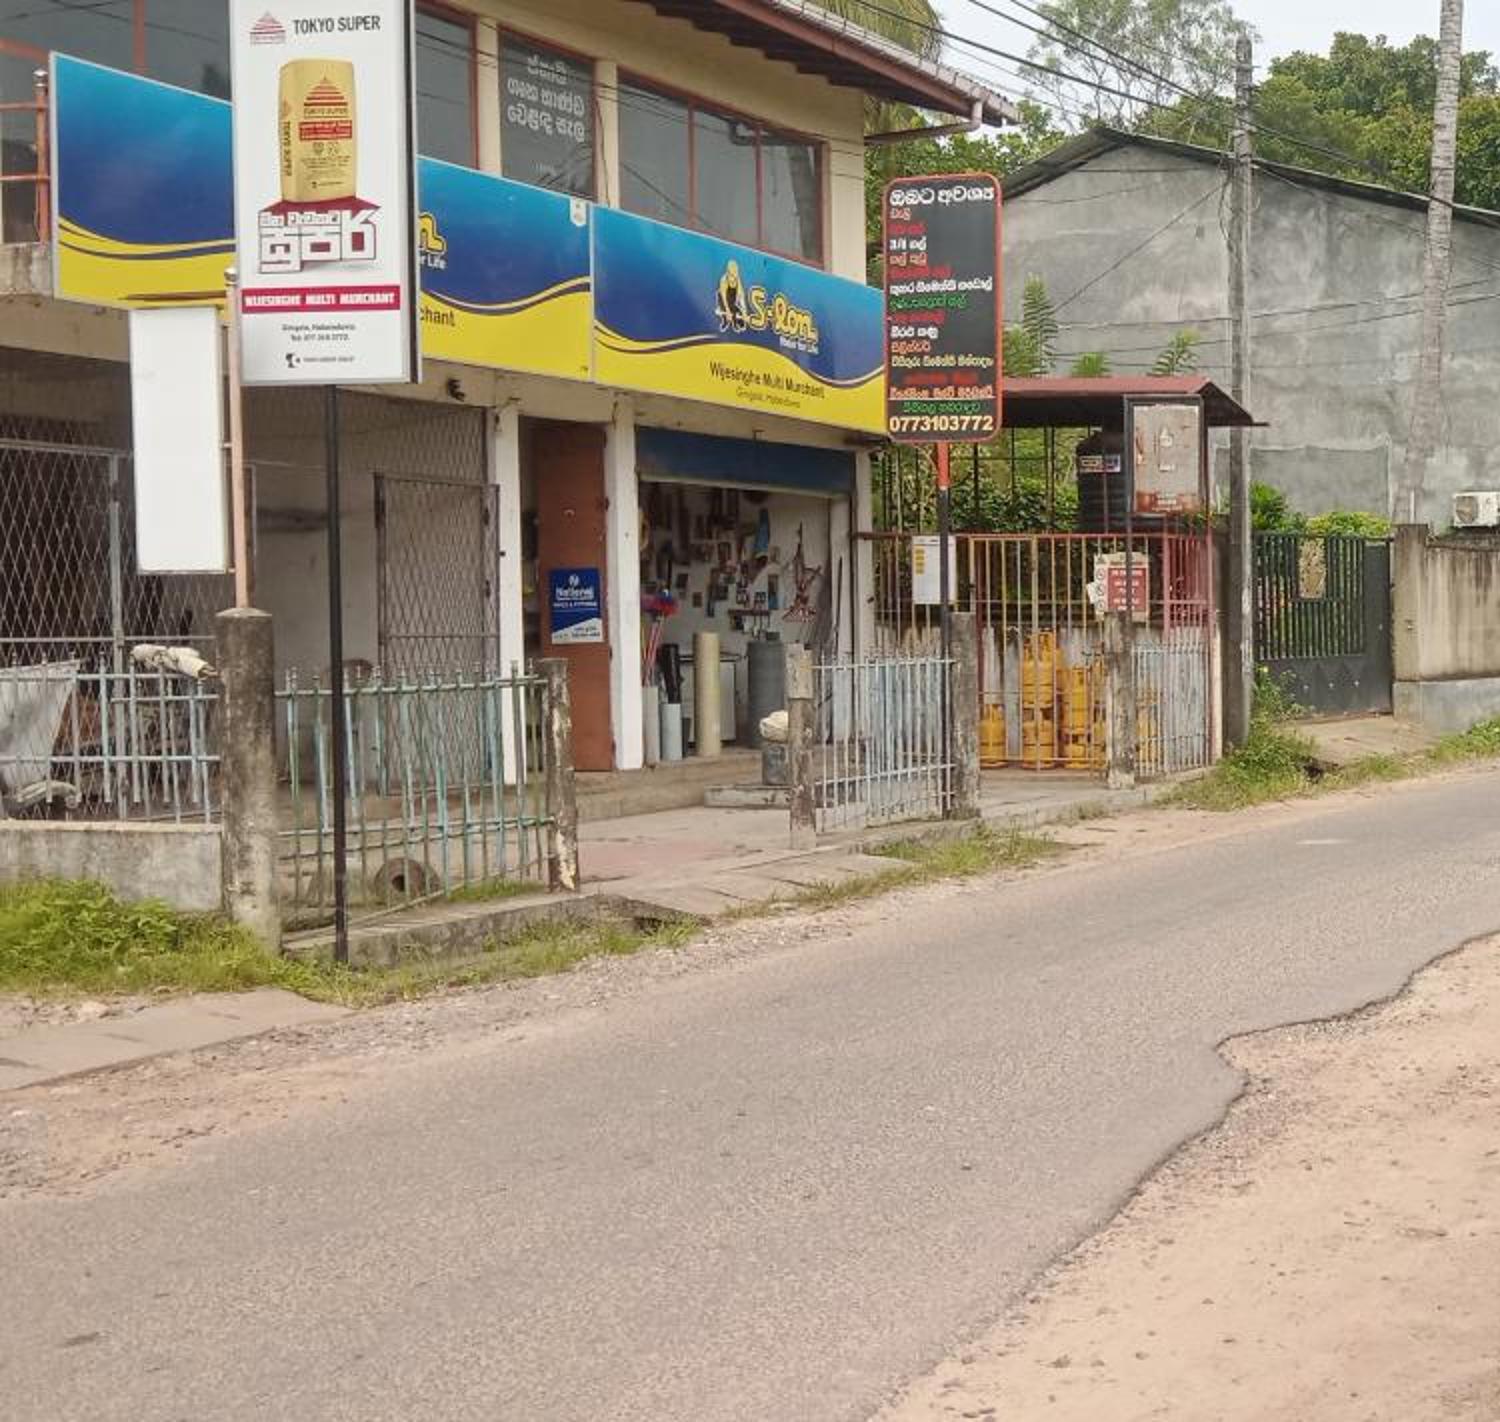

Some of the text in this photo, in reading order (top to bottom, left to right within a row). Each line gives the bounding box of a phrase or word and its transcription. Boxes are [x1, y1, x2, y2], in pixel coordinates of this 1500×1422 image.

[292, 15, 381, 35] TOKYO SUPER
[890, 187, 935, 207] ඔබට
[428, 256, 447, 270] Life
[420, 307, 455, 327] chant
[709, 361, 761, 385] Wijesinghe
[763, 373, 784, 390] Multi
[889, 415, 993, 432] 0773103772
